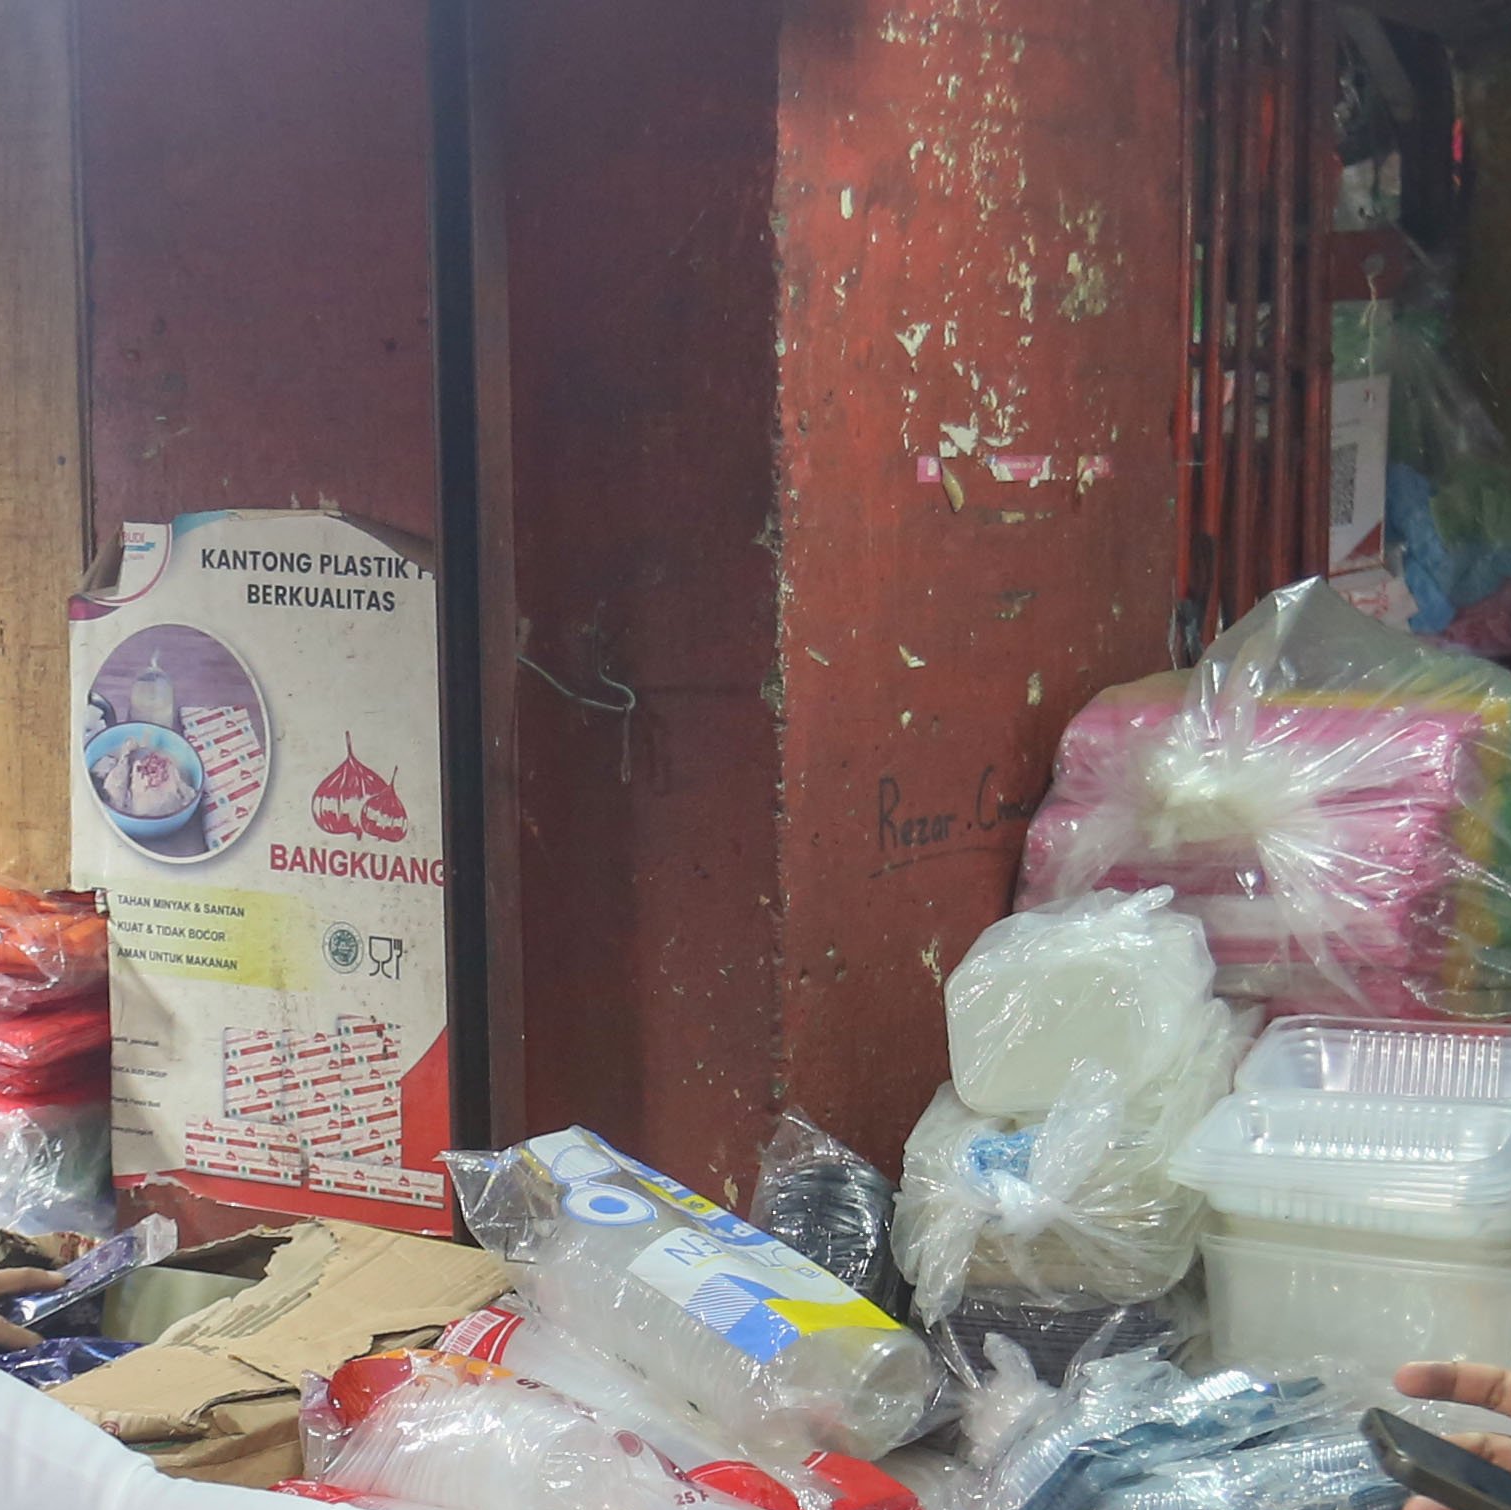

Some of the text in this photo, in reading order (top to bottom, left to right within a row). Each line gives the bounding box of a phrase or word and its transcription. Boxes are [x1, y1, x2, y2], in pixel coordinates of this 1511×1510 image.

[201, 548, 312, 574] KANTONG
[319, 554, 409, 579] PLASTIK
[246, 583, 396, 612] BERKUALITAS
[117, 894, 246, 918] TAHAN MINYAK & SANTAN
[117, 920, 226, 942] KUAT & TIDAK BOCOR
[116, 947, 238, 971] AMAN UNTUK MAKANAN
